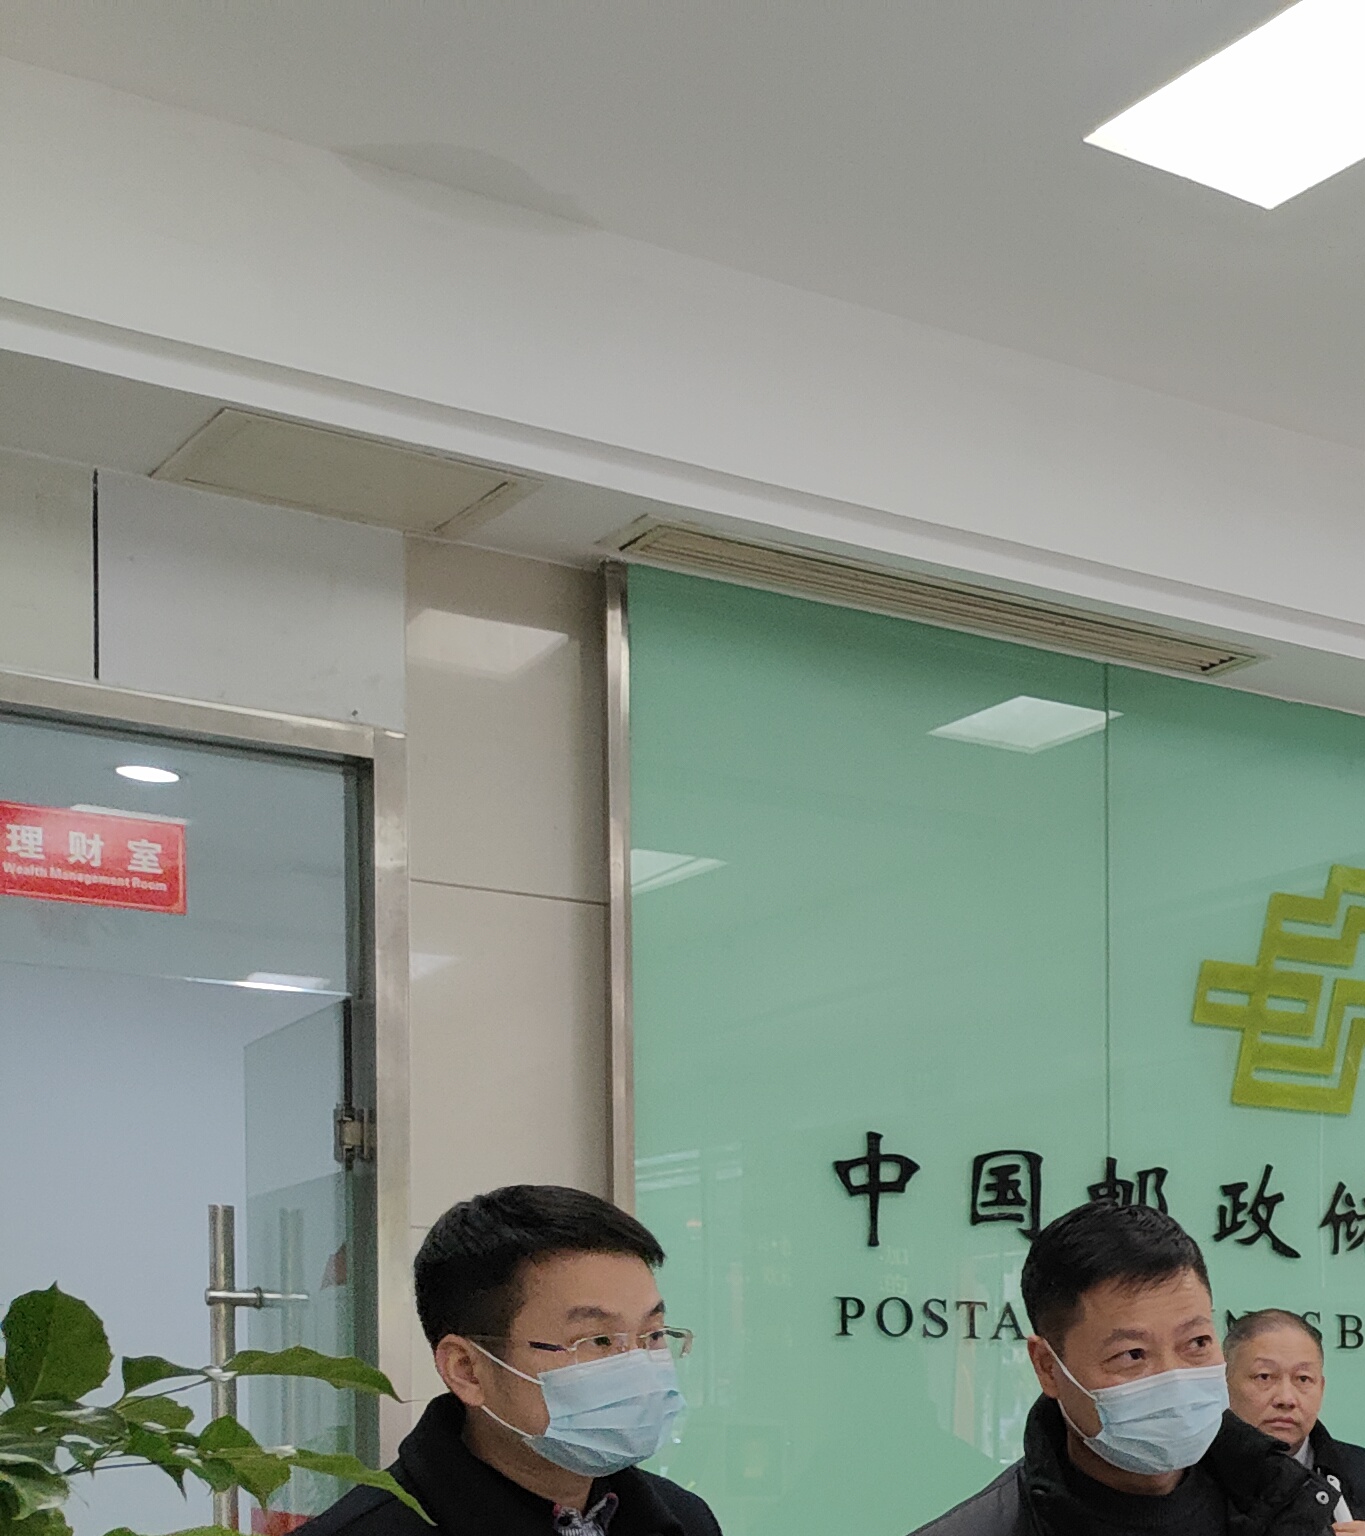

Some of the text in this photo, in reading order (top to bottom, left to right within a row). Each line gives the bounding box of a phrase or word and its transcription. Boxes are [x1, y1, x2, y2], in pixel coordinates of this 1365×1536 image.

[6, 823, 164, 875] 理财室
[2, 861, 168, 892] Wealth Management Room
